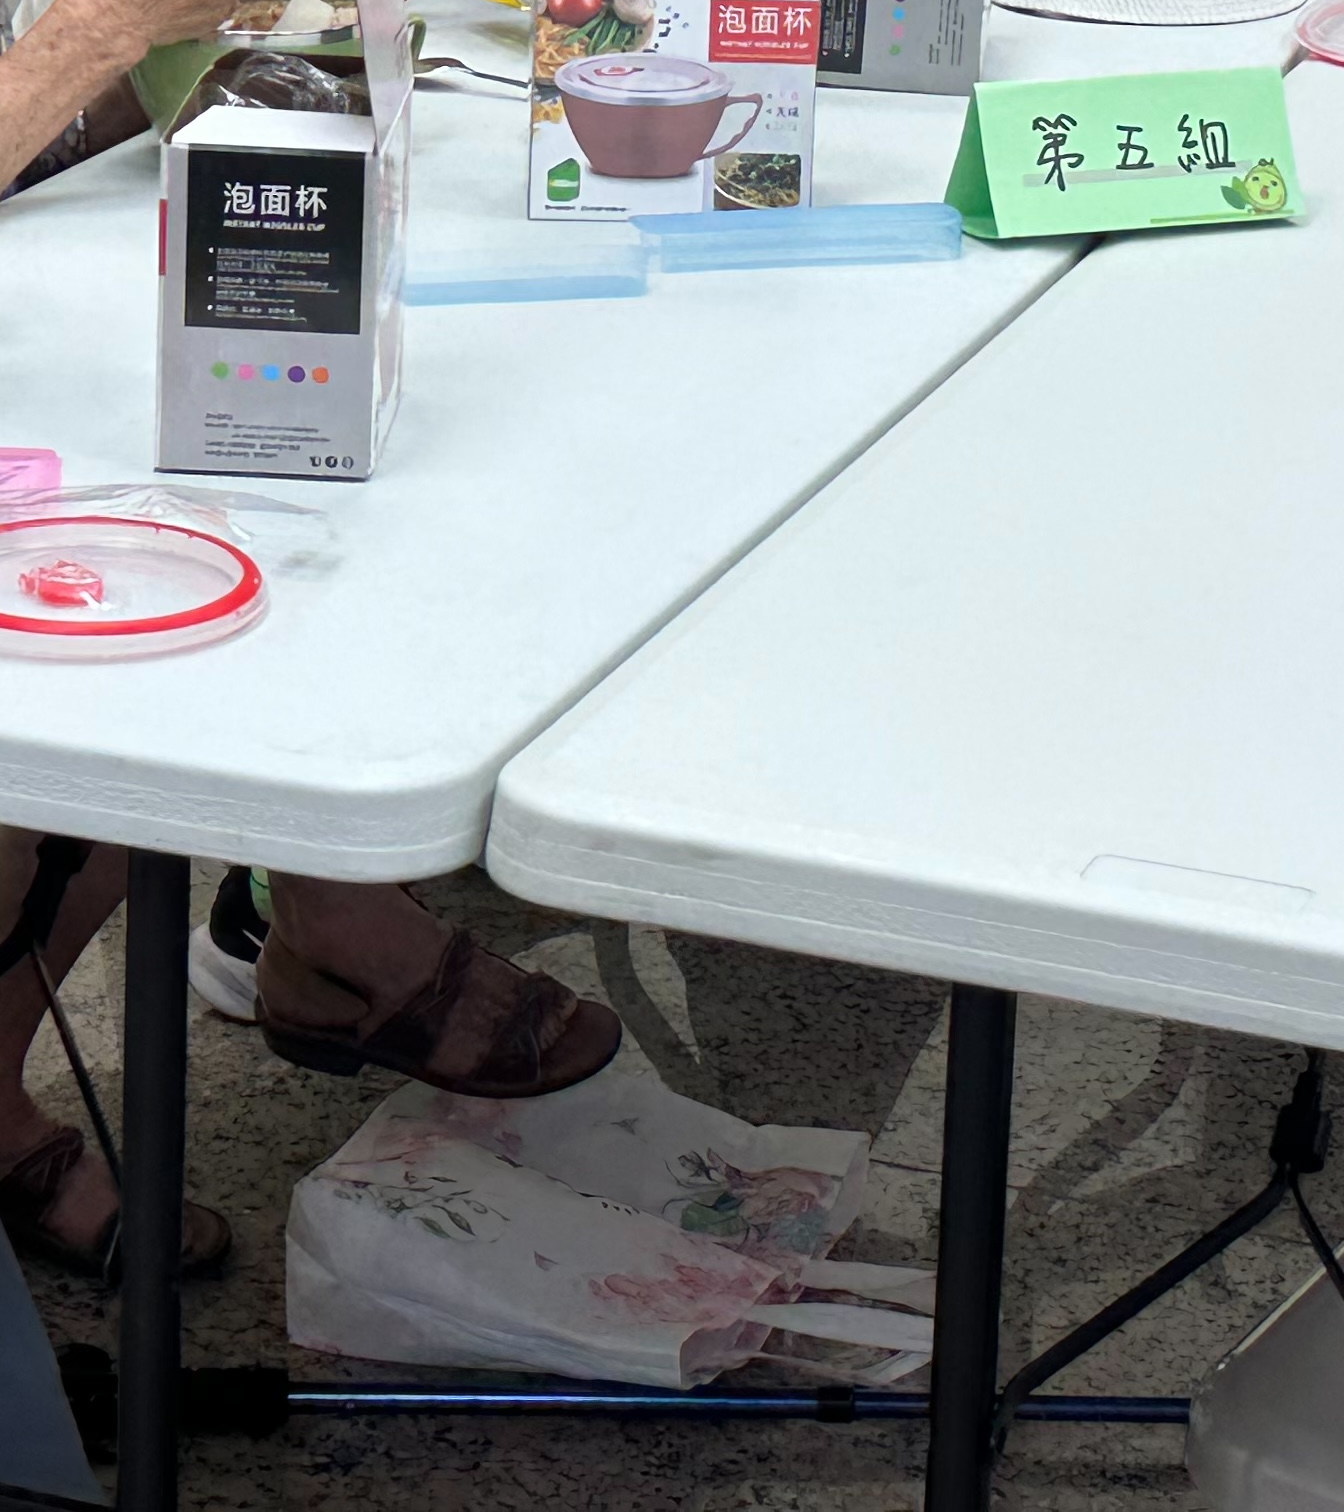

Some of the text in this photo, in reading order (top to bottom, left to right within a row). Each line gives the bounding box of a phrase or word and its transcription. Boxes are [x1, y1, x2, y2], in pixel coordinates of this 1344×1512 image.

[718, 4, 813, 36] 泡面杯
[1031, 113, 1236, 191] 第五組
[223, 181, 329, 219] 泡面杯
